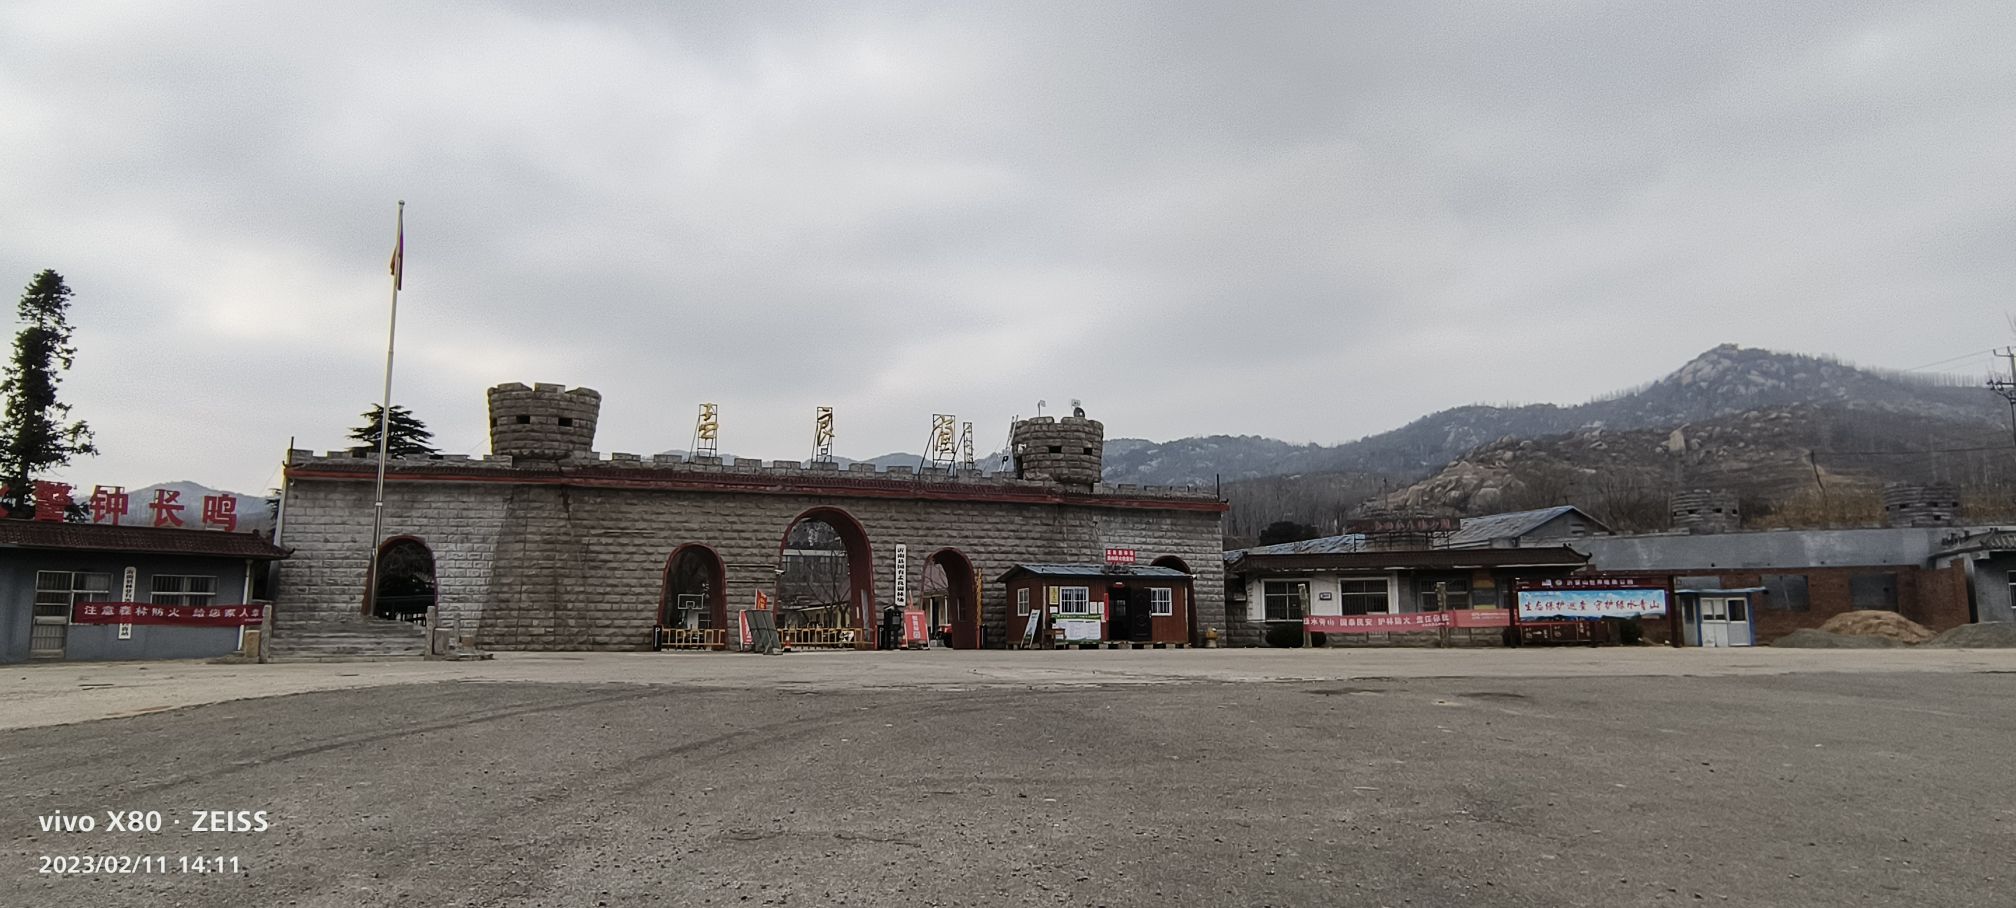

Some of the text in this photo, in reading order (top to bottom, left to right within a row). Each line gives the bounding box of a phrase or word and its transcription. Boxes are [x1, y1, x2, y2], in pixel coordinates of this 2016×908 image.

[35, 480, 237, 532] 警钟长鸣
[84, 605, 264, 618] 注意森林防火 给您家人幸
